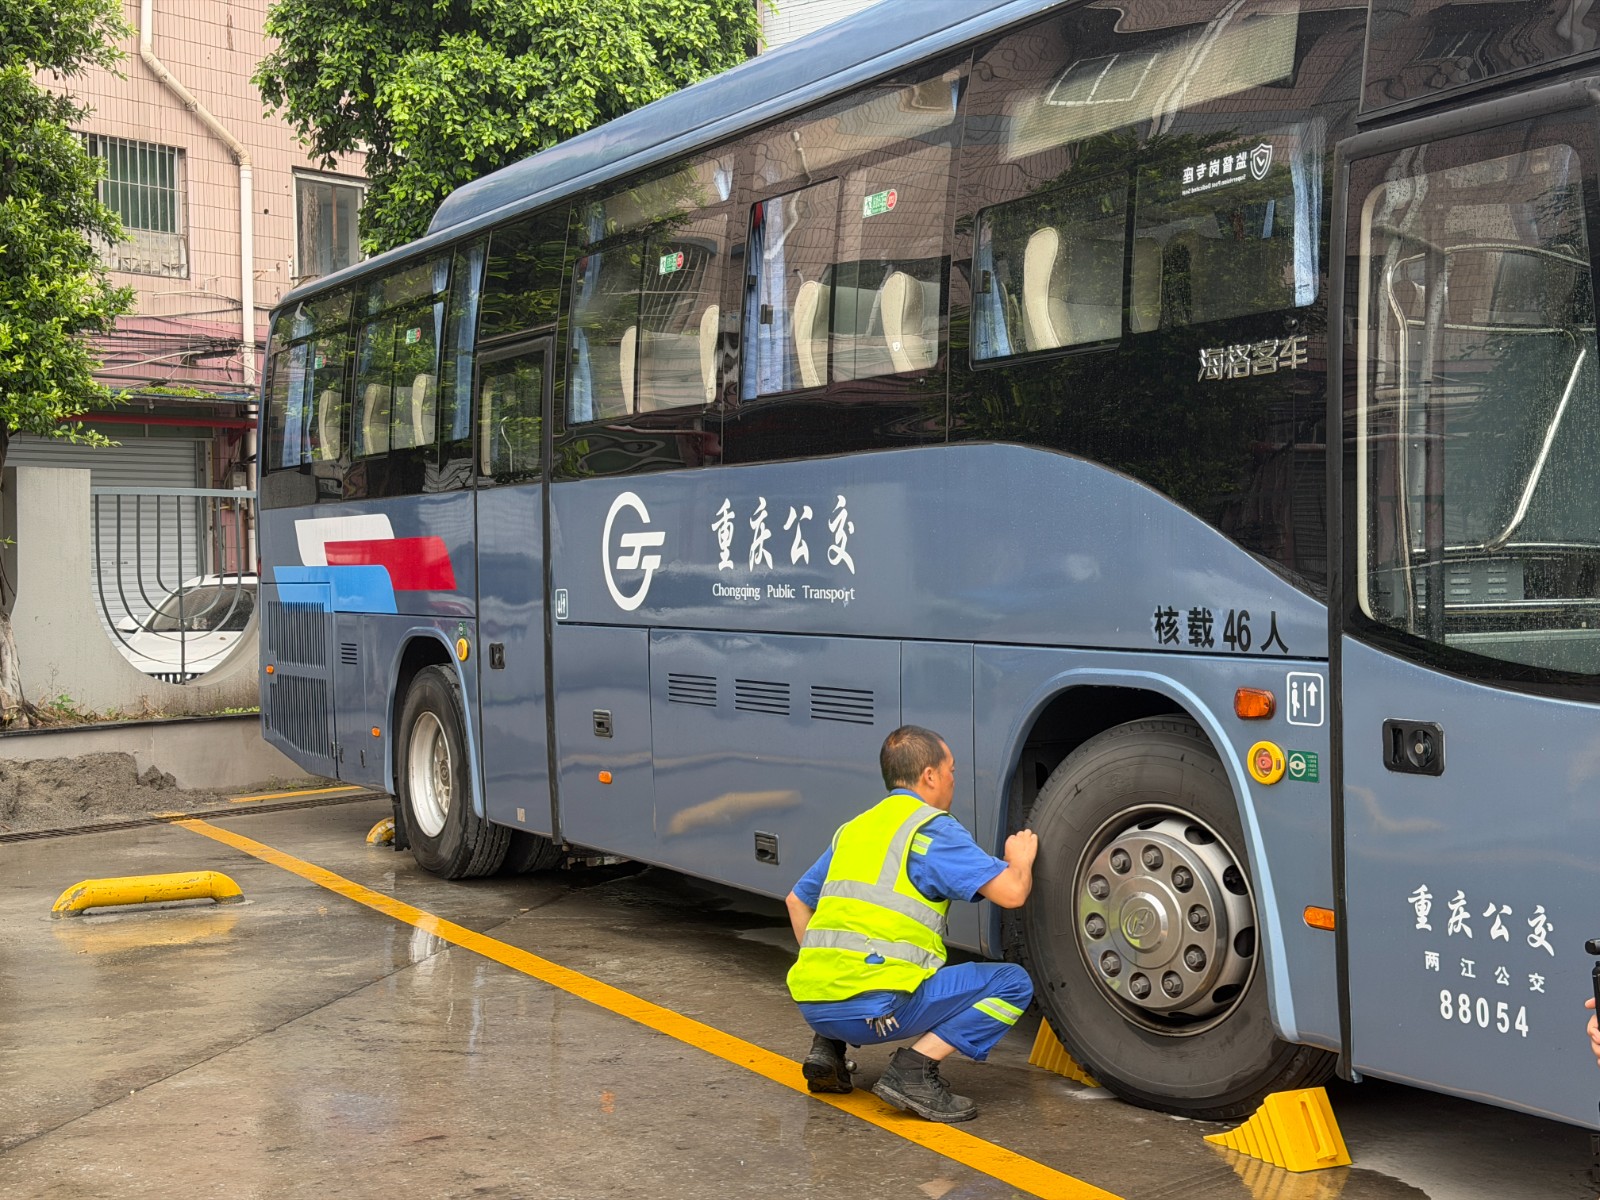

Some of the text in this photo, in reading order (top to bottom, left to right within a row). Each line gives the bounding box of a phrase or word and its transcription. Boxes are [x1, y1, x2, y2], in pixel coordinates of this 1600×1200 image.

[1198, 335, 1308, 382] 海格客车
[711, 494, 855, 575] 重庆公交
[712, 583, 855, 602] Chongqing Public Transport
[1154, 605, 1289, 654] 核载46人
[1408, 884, 1555, 957] 重庆公交
[1424, 950, 1546, 994] 两江公交
[1440, 990, 1529, 1037] 88054
